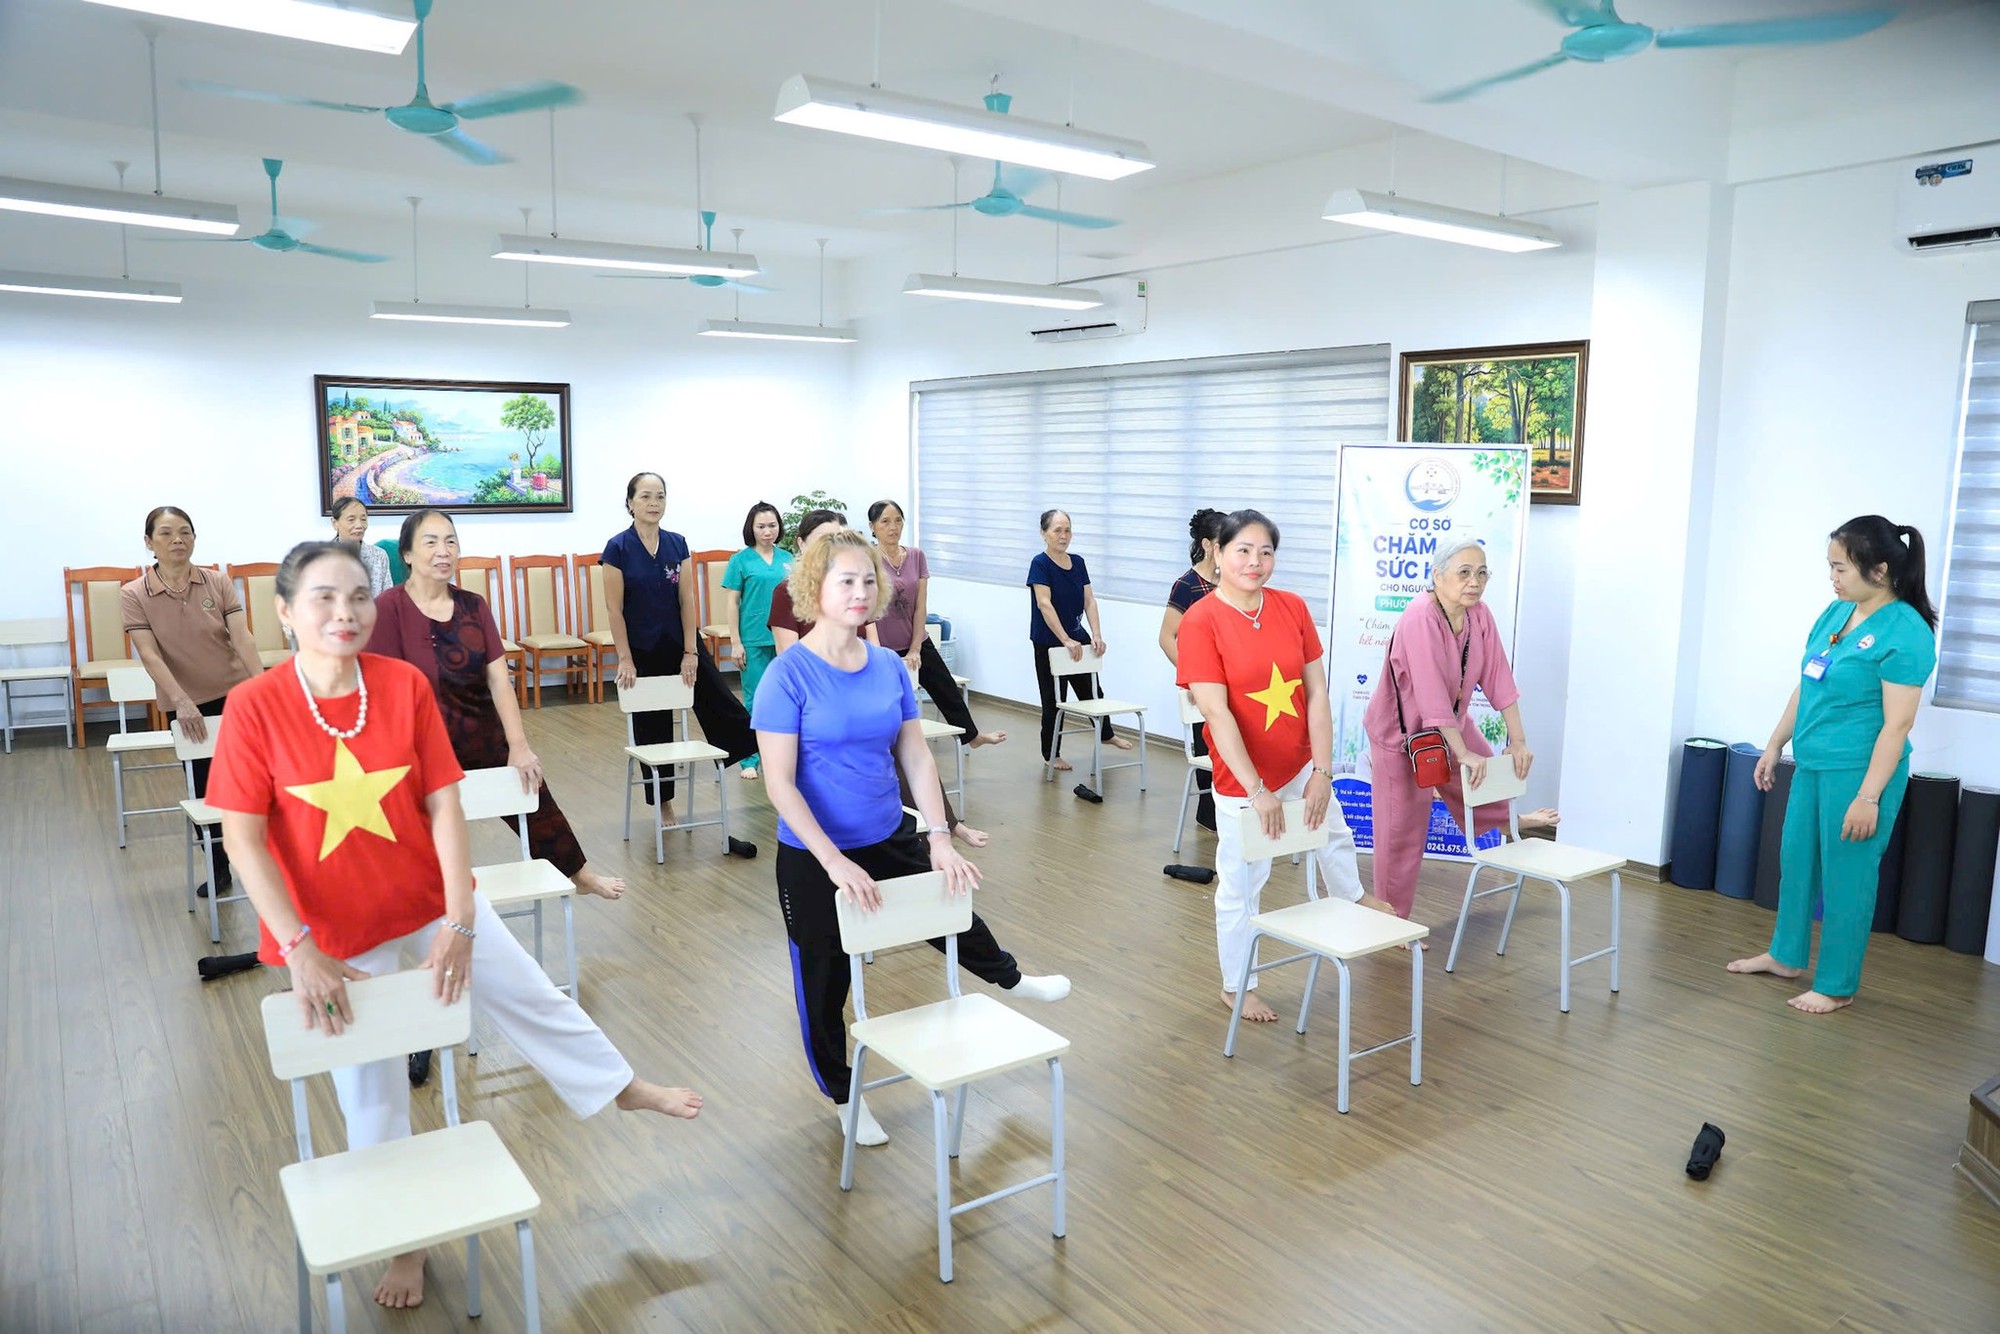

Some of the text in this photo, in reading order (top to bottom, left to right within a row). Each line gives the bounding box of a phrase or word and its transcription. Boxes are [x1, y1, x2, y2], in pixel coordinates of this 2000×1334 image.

[1409, 516, 1452, 531] CƠ SỞ
[1373, 532, 1437, 555] CHĂM
[1376, 556, 1419, 579] SỨC
[1380, 584, 1400, 592] CHO
[1380, 597, 1408, 608] PHƯỜ
